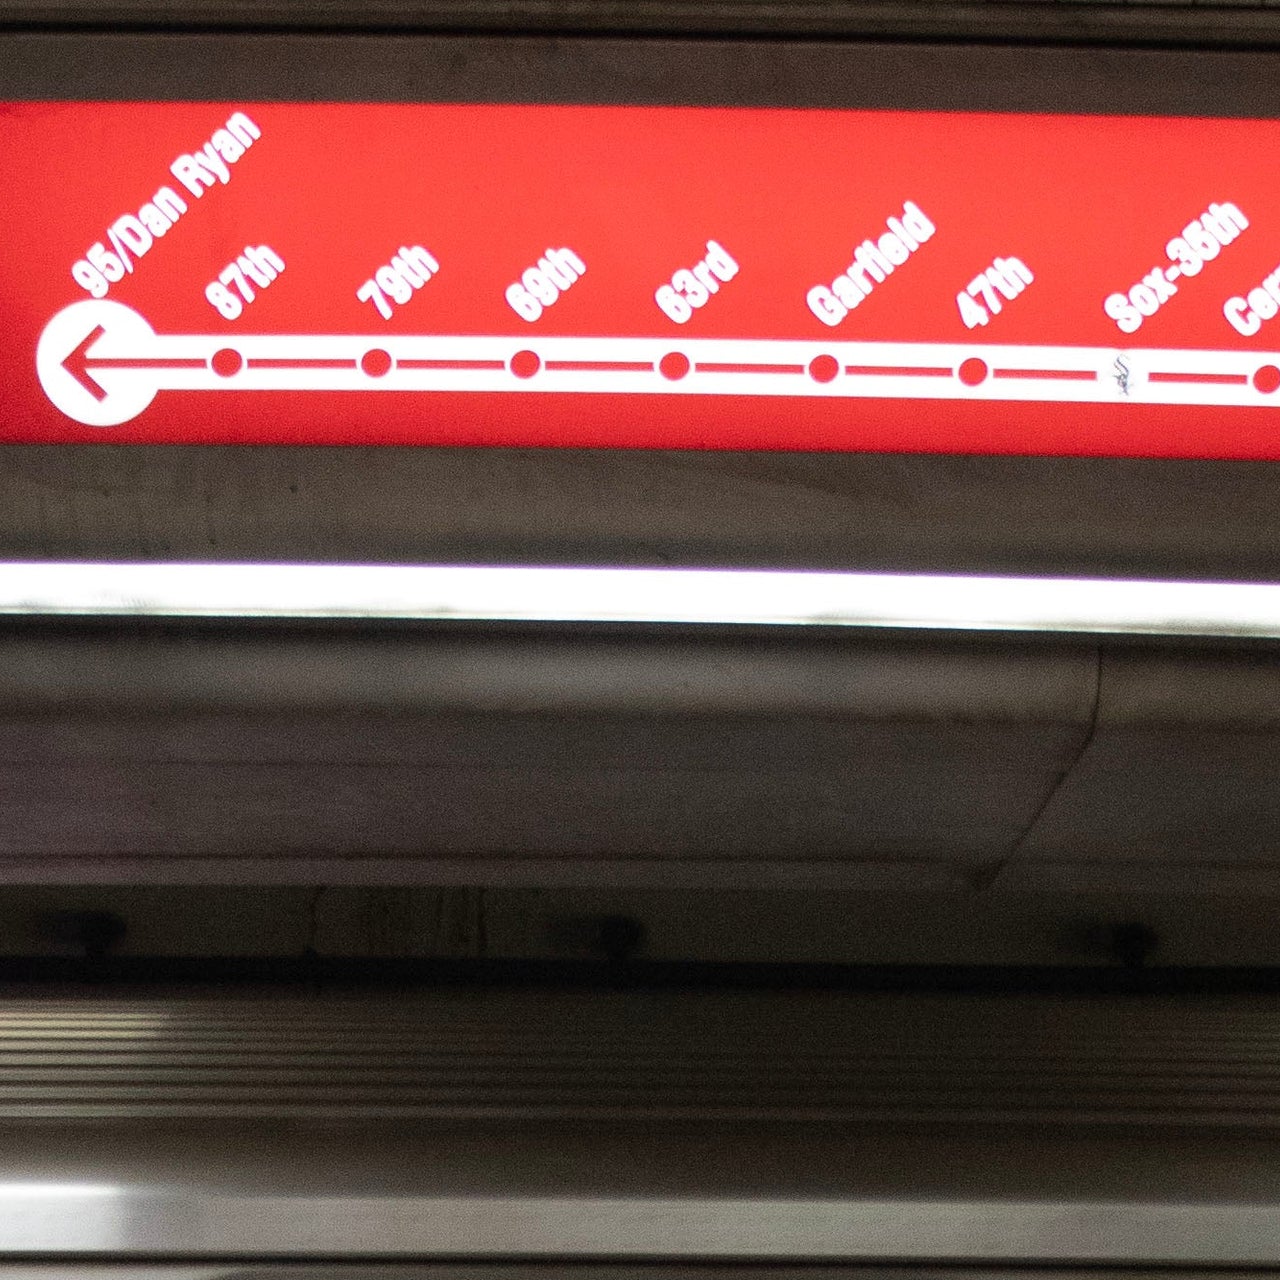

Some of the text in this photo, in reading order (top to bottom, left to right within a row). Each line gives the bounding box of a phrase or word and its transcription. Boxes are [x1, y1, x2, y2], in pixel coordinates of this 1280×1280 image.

[71, 111, 262, 299] 95/Dan Ryan
[205, 244, 286, 321] 87th
[356, 245, 440, 321] 79th
[505, 247, 587, 323] 69th
[654, 239, 740, 324] 63rd
[806, 200, 936, 327] Garfield
[956, 256, 1034, 329] 47th
[1104, 201, 1250, 334] Sox-35th
